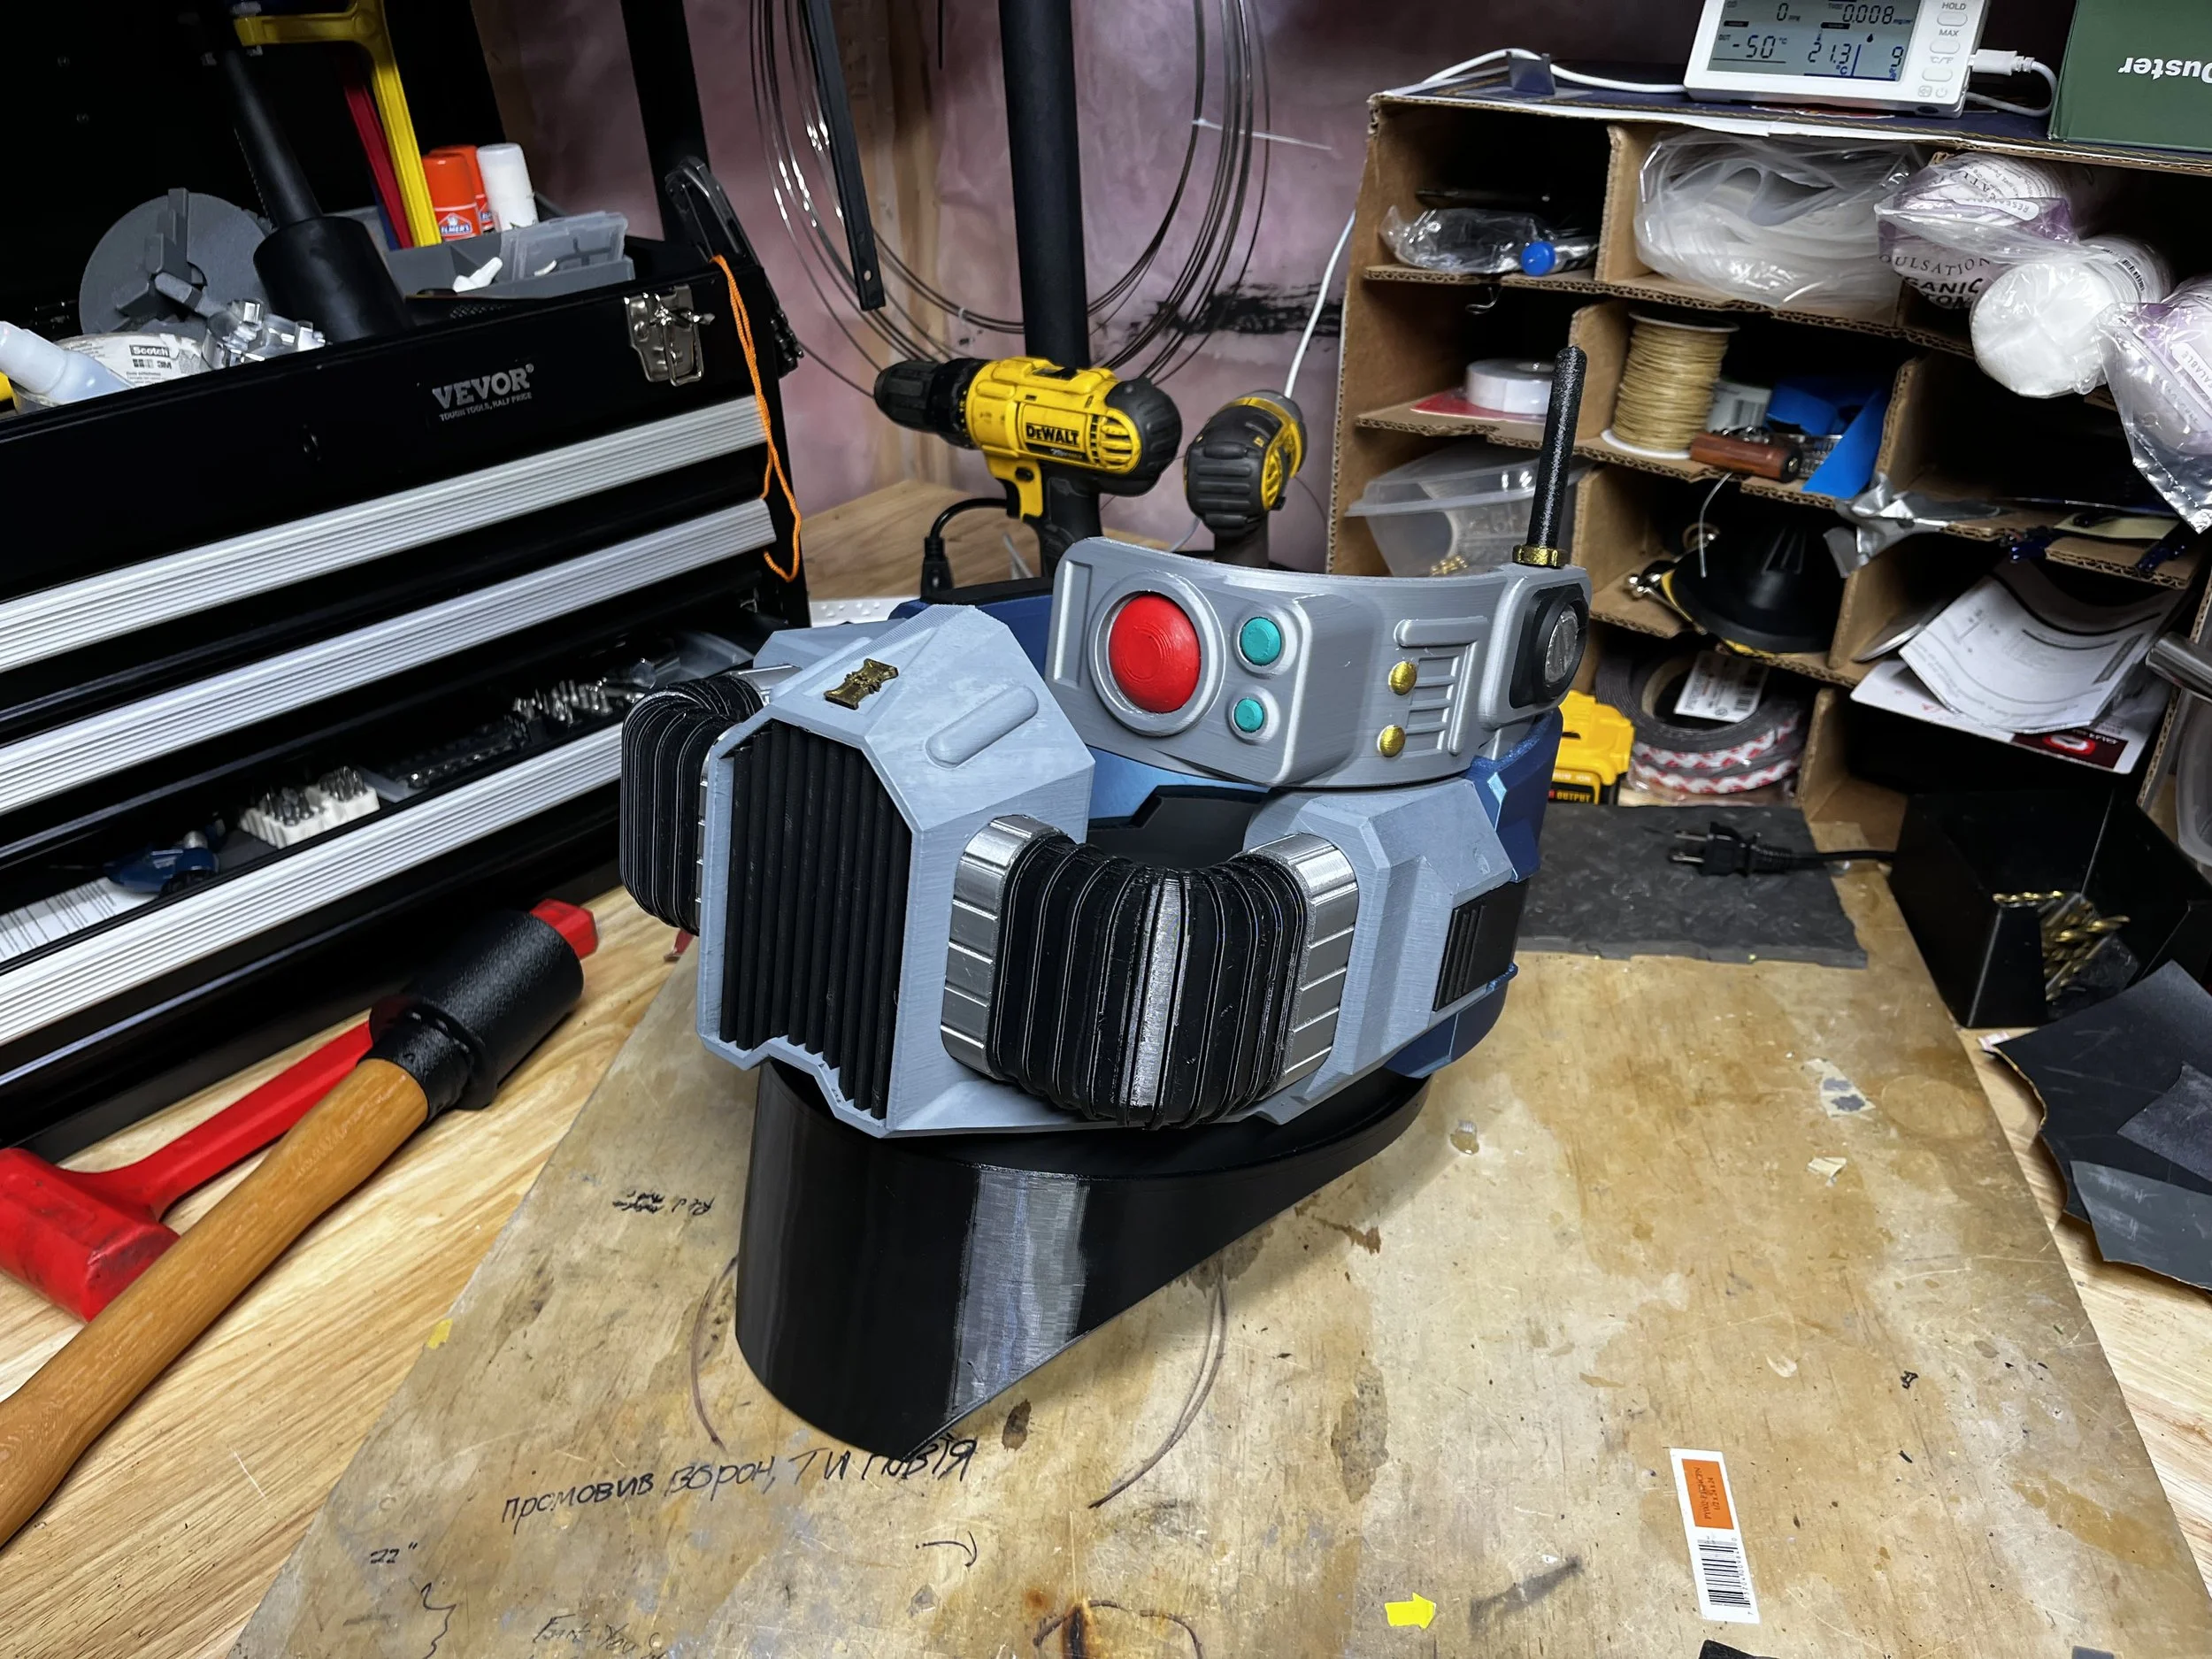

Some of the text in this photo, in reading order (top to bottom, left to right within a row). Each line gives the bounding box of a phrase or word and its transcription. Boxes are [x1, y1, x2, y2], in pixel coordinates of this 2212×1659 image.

[1842, 4, 1894, 25] 0.008
[1808, 42, 1852, 65] 21.3
[132, 345, 169, 357] Scotch
[493, 396, 511, 407] HALF
[511, 391, 533, 403] PRICE
[1556, 790, 1592, 803] OUTPUT
